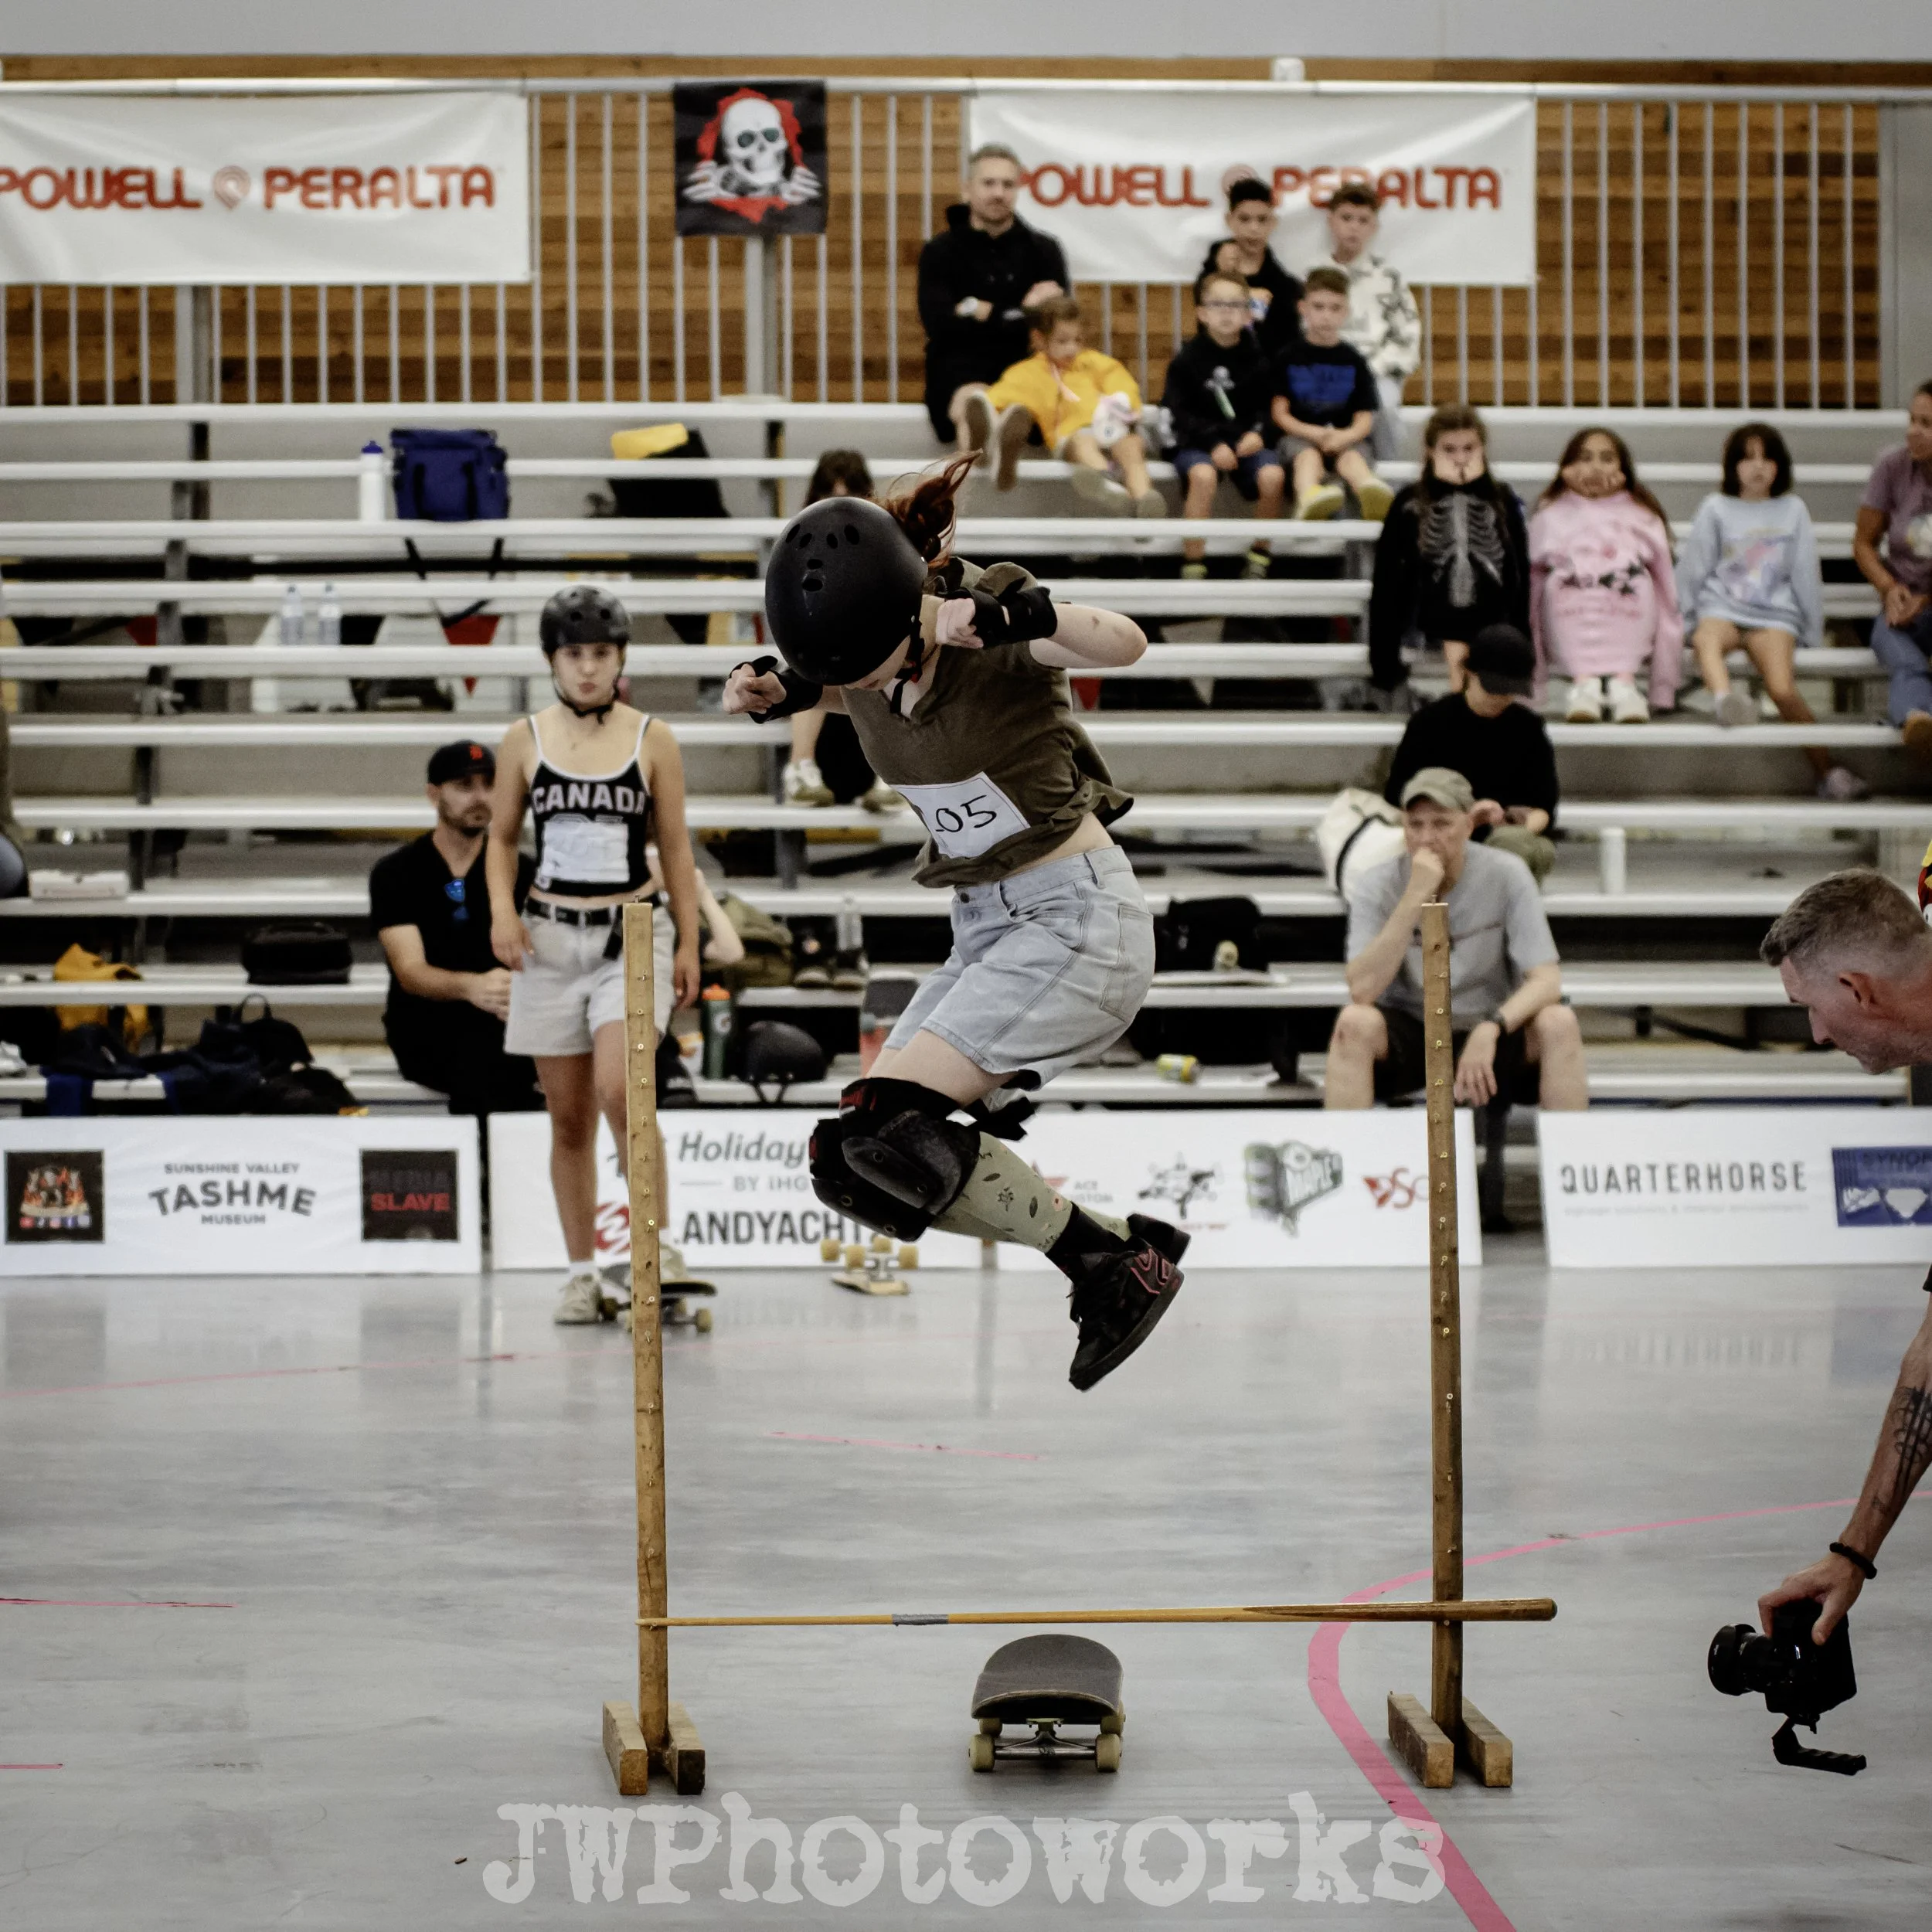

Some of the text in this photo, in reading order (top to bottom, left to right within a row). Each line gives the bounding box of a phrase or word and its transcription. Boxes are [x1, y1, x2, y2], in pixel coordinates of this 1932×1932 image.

[264, 165, 495, 209] PERALTA
[1018, 162, 1211, 207] OWELL
[936, 795, 997, 832] 05
[680, 1131, 807, 1168] Holiday
[165, 1163, 300, 1174] SUNSHINE VALLEY
[734, 1176, 809, 1191] BY IHG
[148, 1179, 316, 1216] TASHME
[371, 1192, 449, 1211] SLAVE
[201, 1214, 265, 1224] MUSEUM
[675, 1210, 877, 1244] ANDYACH
